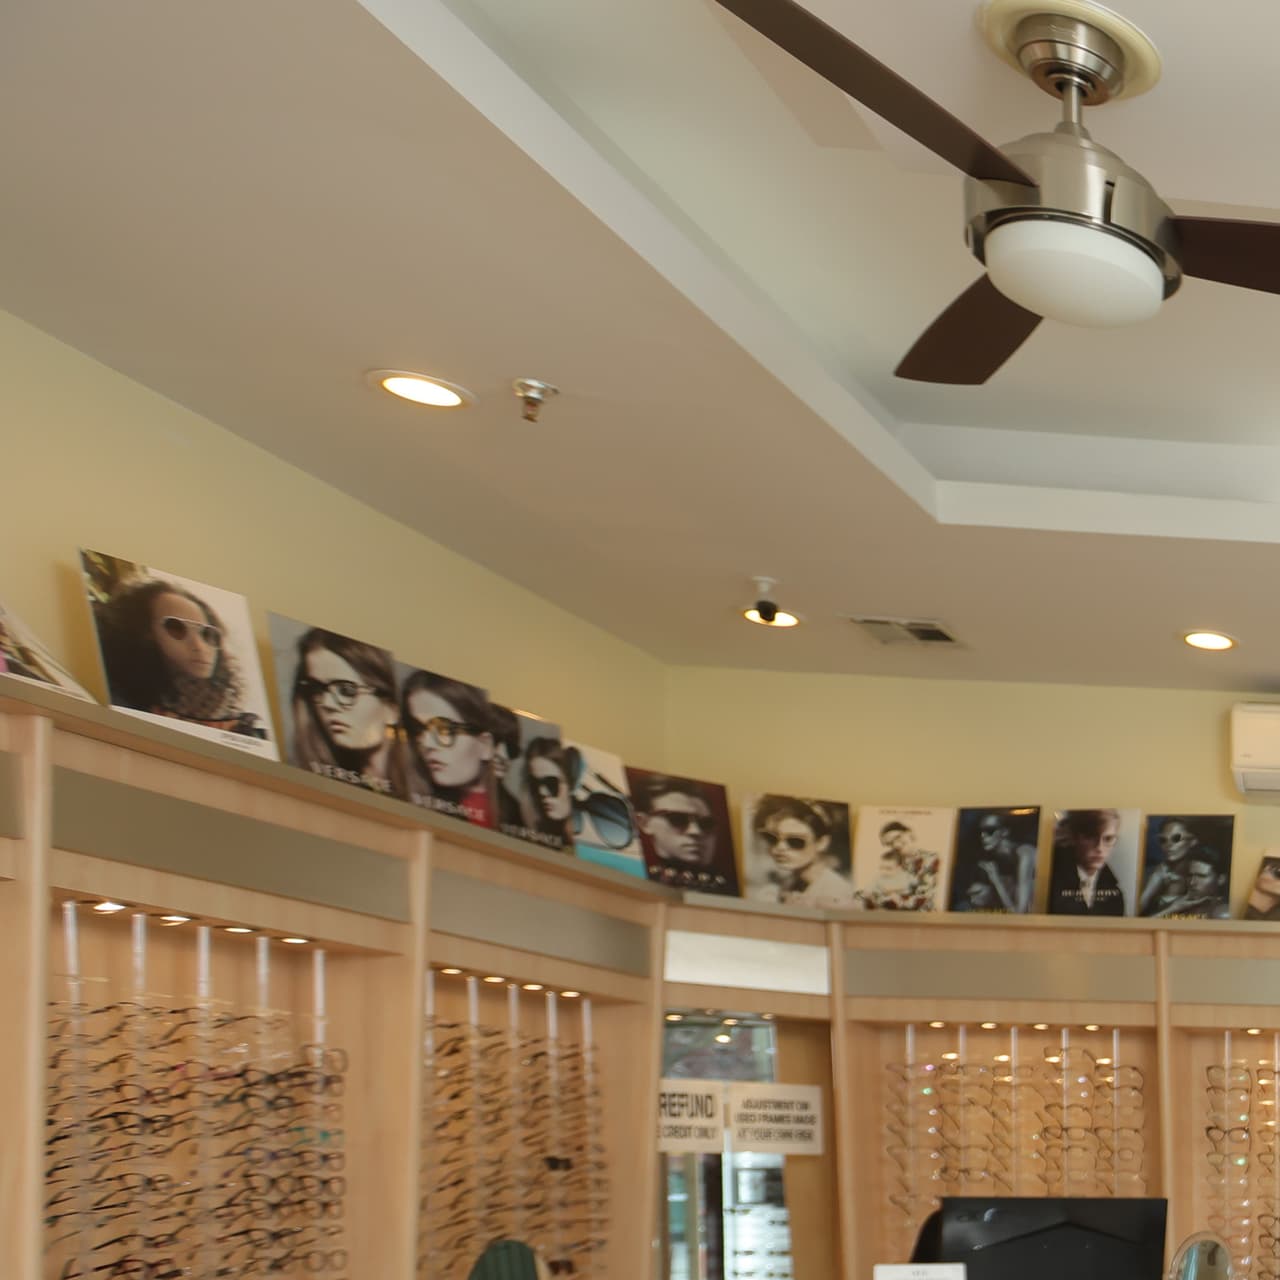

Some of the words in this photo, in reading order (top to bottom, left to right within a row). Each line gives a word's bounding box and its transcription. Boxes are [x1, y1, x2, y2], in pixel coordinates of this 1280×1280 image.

[308, 760, 393, 793] VERSACE
[411, 792, 487, 822] VERSACE
[659, 1091, 714, 1118] REFUND
